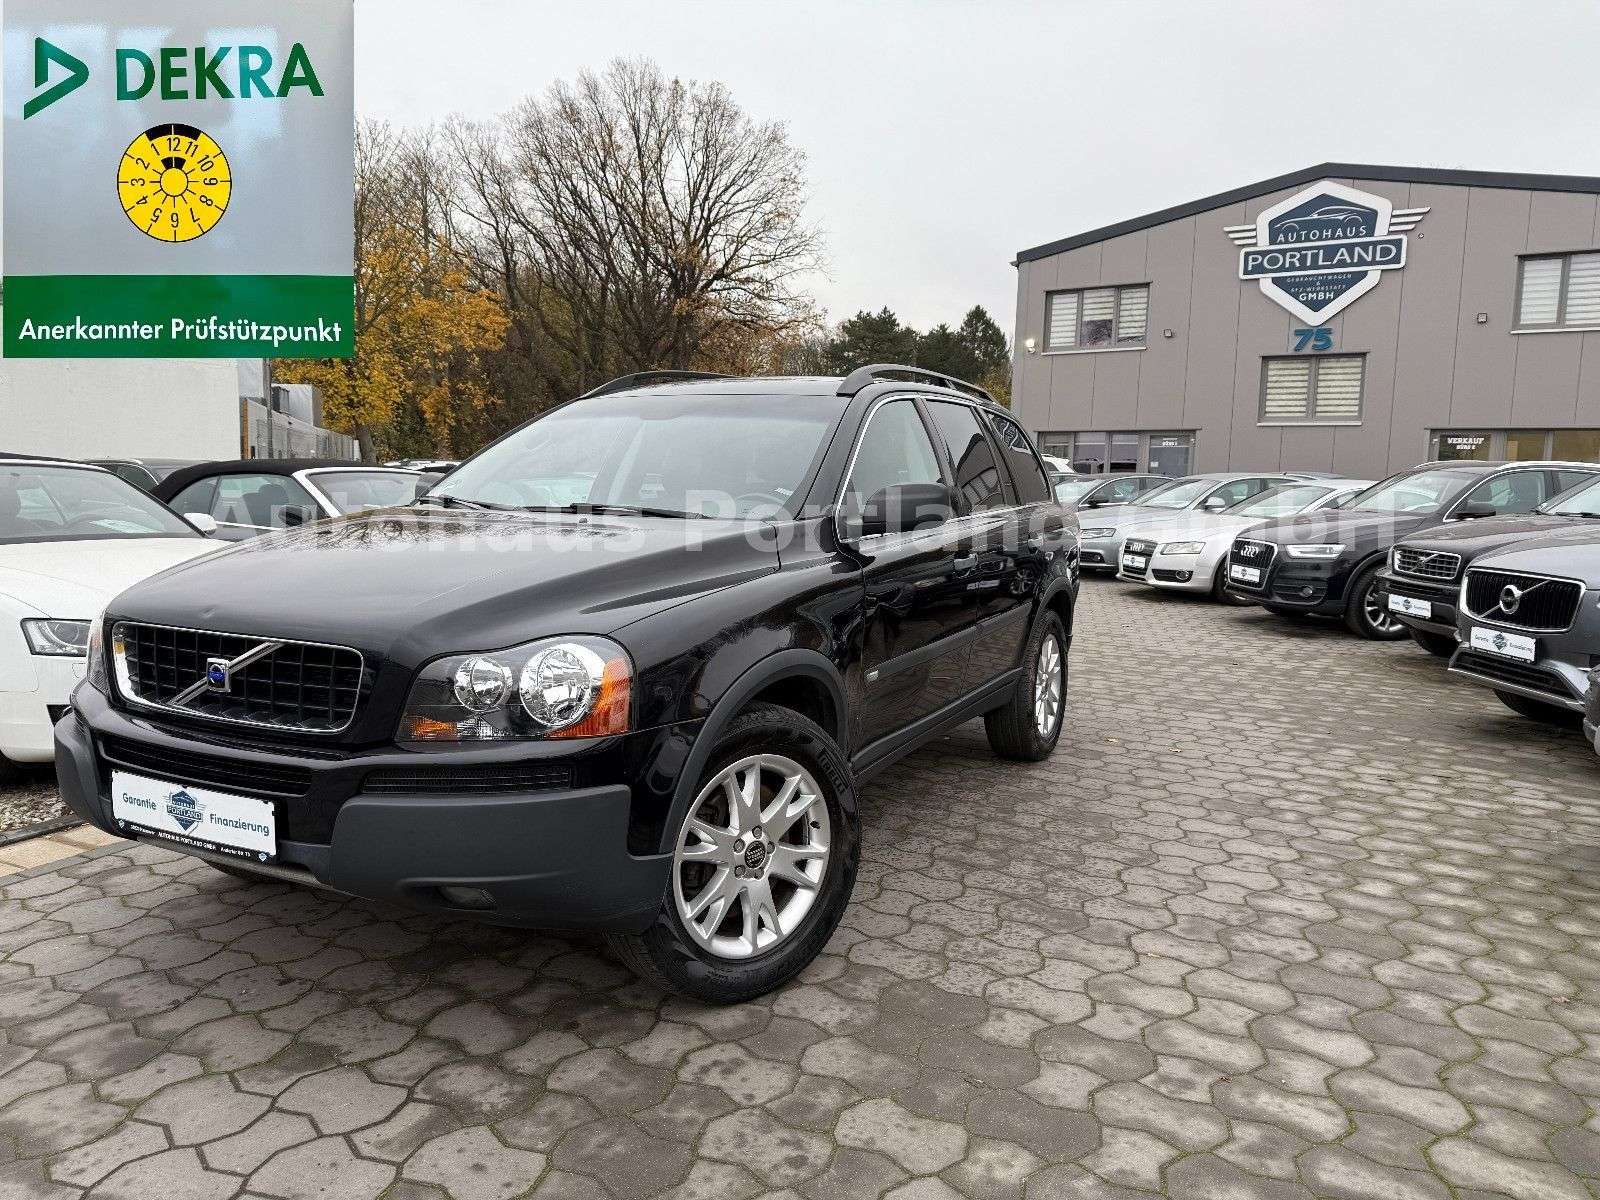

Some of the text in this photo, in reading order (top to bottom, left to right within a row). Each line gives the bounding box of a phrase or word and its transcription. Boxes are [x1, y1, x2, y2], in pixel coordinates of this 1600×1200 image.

[1276, 225, 1367, 243] AUTOHAUS
[1247, 244, 1397, 271] PORTLAND
[1299, 291, 1334, 301] GMBH
[1293, 327, 1333, 352] 75
[122, 792, 157, 810] Garantie
[209, 813, 270, 837] Finanzierung
